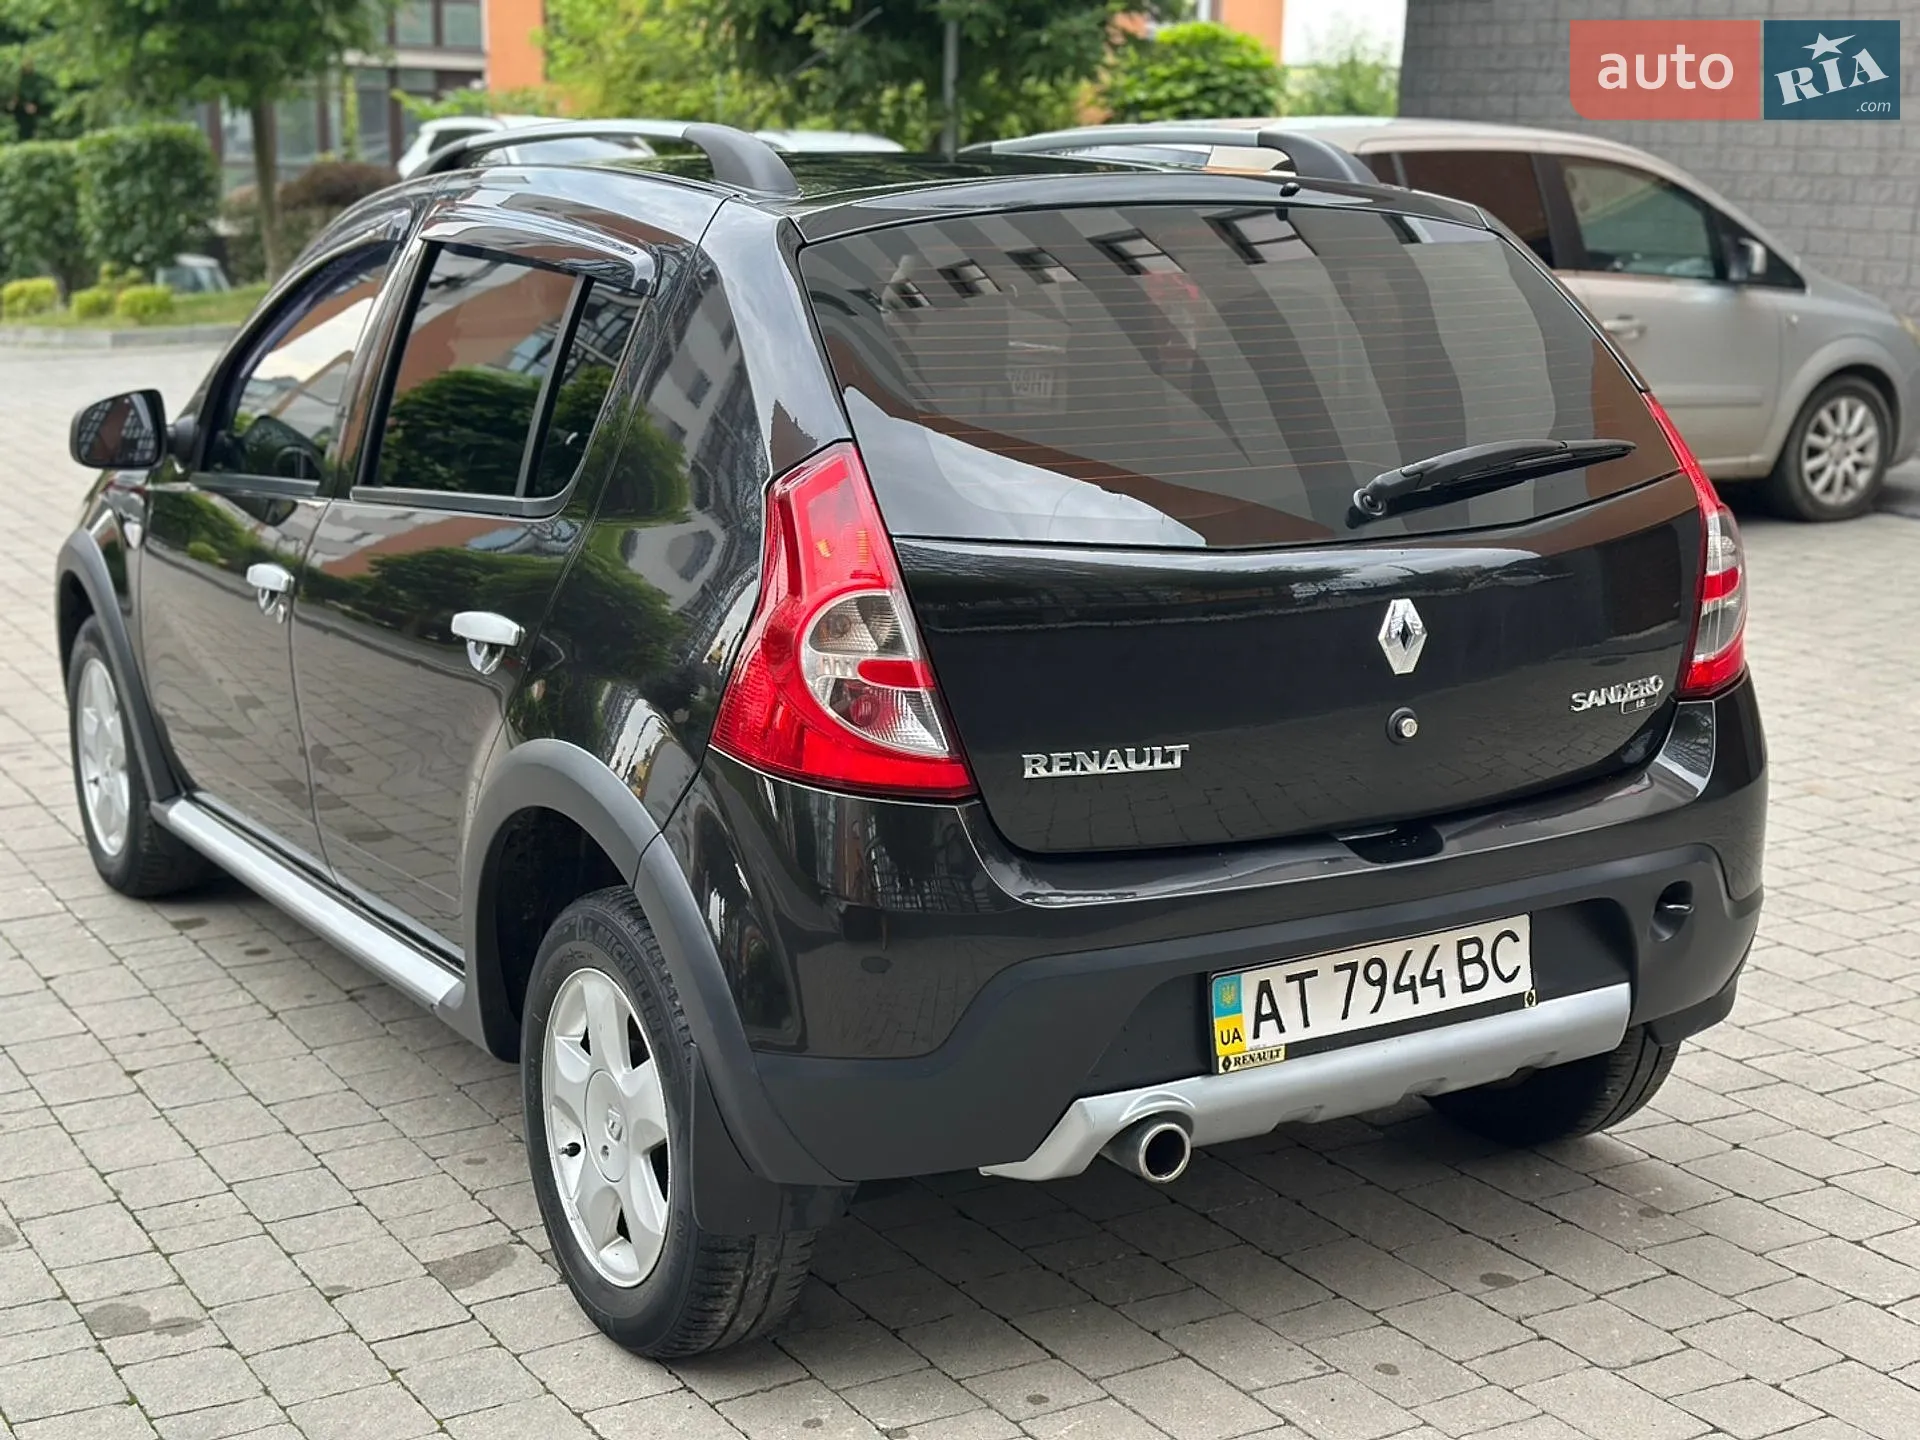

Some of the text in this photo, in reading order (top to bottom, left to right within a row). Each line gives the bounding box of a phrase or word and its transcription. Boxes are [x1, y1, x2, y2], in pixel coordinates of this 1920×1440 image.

[1570, 674, 1664, 712] SANDERO
[1022, 744, 1190, 779] RENAULT
[1253, 929, 1520, 1040] AT 7944 BC
[1221, 1027, 1243, 1045] UA
[1233, 1048, 1282, 1067] RENAULT
